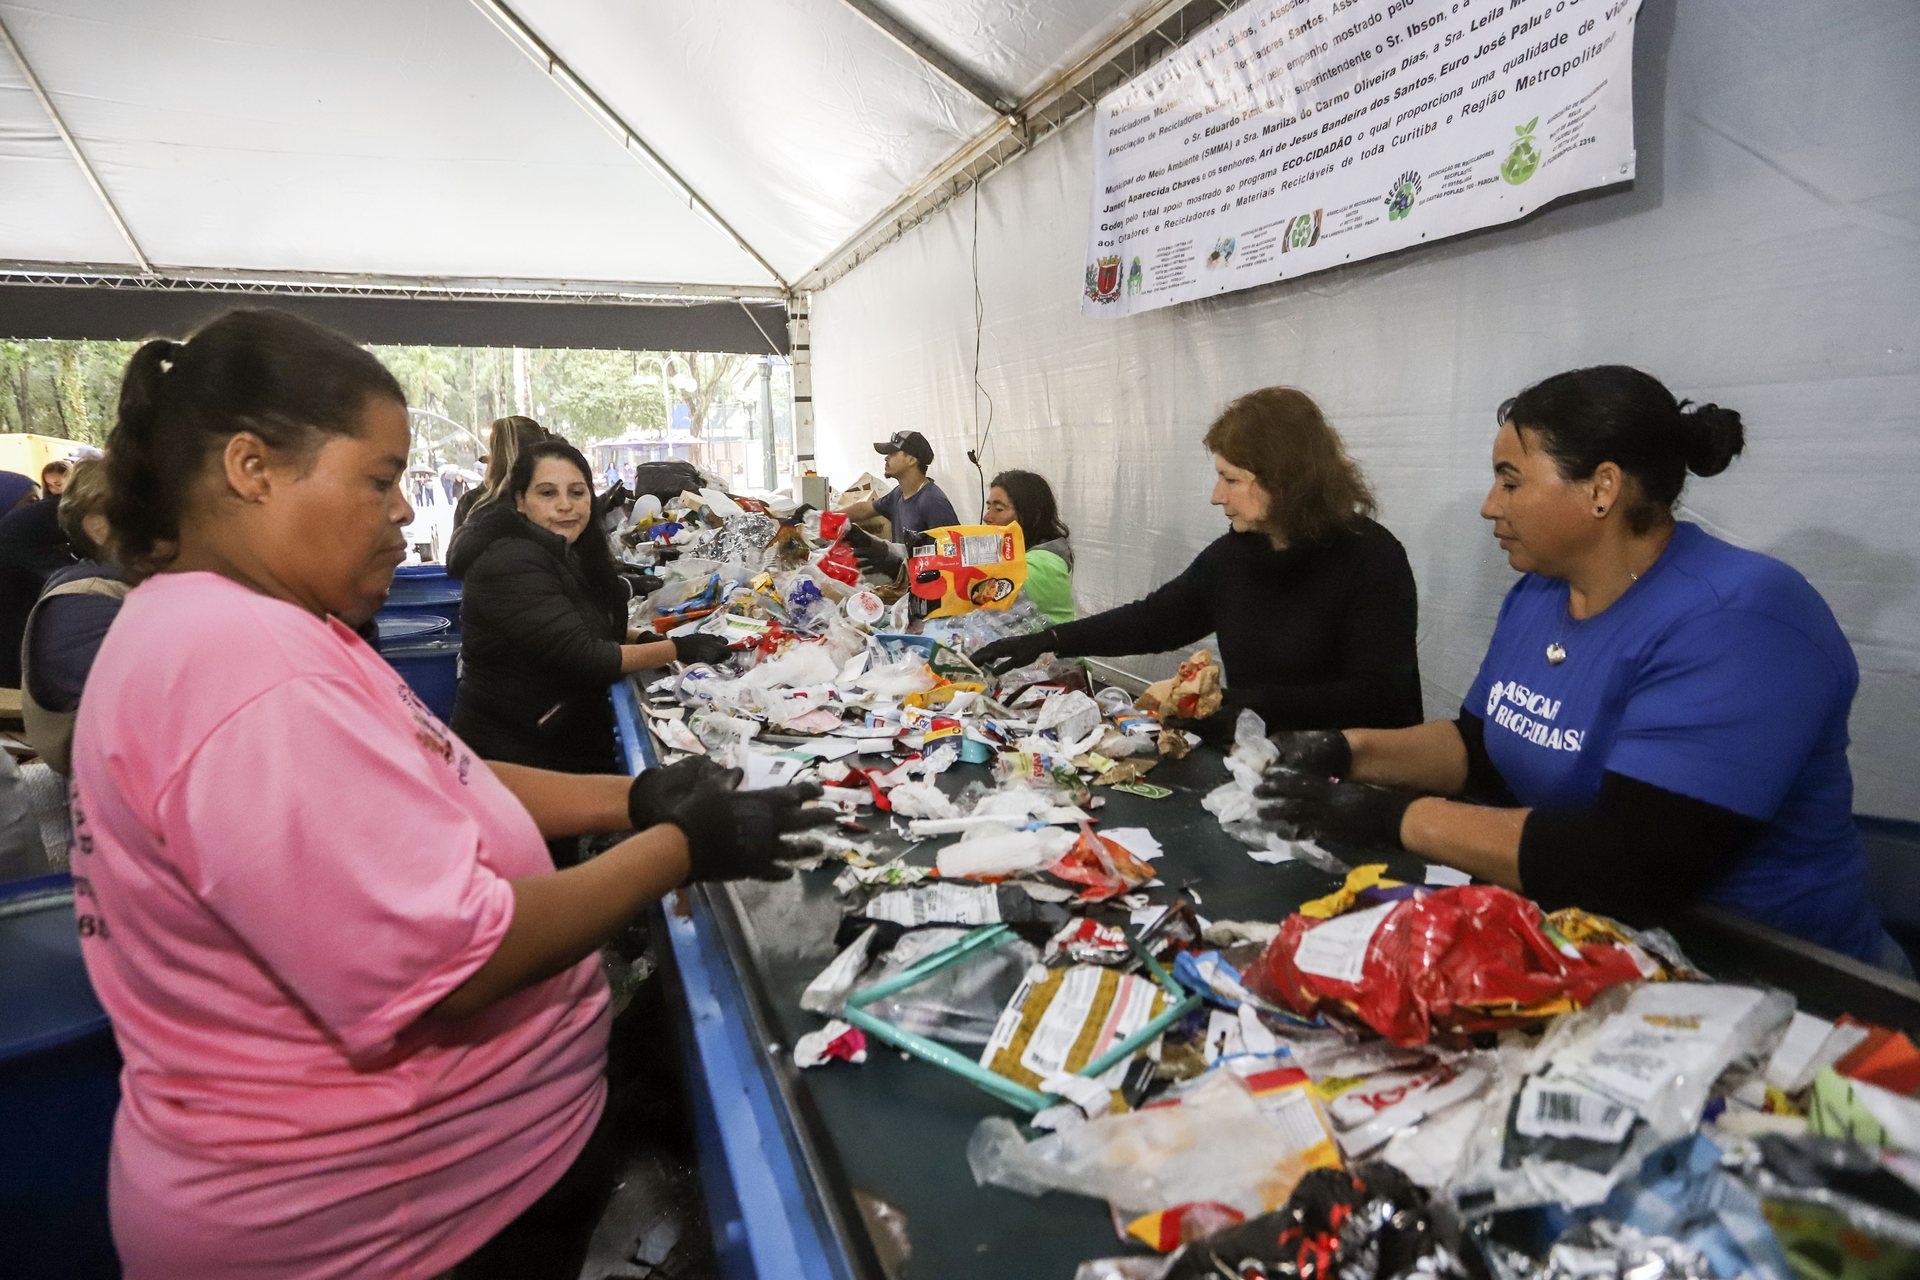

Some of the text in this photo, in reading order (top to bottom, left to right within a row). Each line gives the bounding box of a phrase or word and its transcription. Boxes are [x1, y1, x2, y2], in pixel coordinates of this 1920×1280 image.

[1108, 135, 1146, 158] Associação
[1147, 131, 1156, 142] de
[1158, 110, 1203, 136] Recicladores
[1286, 41, 1329, 71] empenho
[1332, 12, 1383, 47] mostrado
[1127, 186, 1170, 205] Aparecida
[1171, 173, 1201, 192] Chaves
[1207, 169, 1217, 178] os
[1218, 155, 1257, 174] senhores,
[1258, 145, 1273, 160] Ari
[1275, 141, 1287, 153] de
[1289, 127, 1319, 148] Jesus
[1321, 106, 1367, 135] Bandeira
[1369, 95, 1390, 112] dos
[1393, 73, 1438, 100] Santos,
[1439, 54, 1470, 77] Euro
[1473, 31, 1507, 60] José
[1510, 13, 1543, 41] Palu
[1544, 7, 1553, 20] e
[1555, 0, 1566, 13] o
[1136, 171, 1147, 183] do
[1148, 167, 1166, 180] Meio
[1167, 154, 1200, 173] Ambiente
[1200, 140, 1233, 161] (SMMA)
[1235, 138, 1241, 148] a
[1243, 131, 1260, 144] Sra.
[1262, 116, 1297, 135] Marilza
[1299, 107, 1313, 121] do
[1315, 91, 1350, 112] Carmo
[1353, 66, 1397, 95] Oliveira
[1400, 51, 1429, 71] Dias,
[1432, 43, 1441, 54] a
[1444, 29, 1466, 48] Sra.
[1470, 6, 1504, 33] Leila
[1183, 136, 1190, 146] o
[1191, 131, 1202, 143] Sr.
[1204, 116, 1240, 138] Eduardo
[1294, 51, 1373, 95] superintendente
[1375, 44, 1384, 55] o
[1385, 33, 1404, 49] Sr.
[1406, 10, 1448, 39] Ibson,
[1451, 3, 1460, 15] e
[1288, 12, 1329, 41] Santos,
[1096, 239, 1115, 248] aos
[1154, 224, 1160, 233] e
[1163, 208, 1216, 229] Recicladores
[1220, 202, 1231, 214] de
[1235, 186, 1275, 208] Materiais
[1280, 163, 1335, 192] Recicláveis
[1341, 156, 1354, 169] de
[1359, 143, 1385, 161] toda
[1391, 120, 1438, 148] Curitiba
[1446, 114, 1454, 125] e
[1460, 88, 1507, 118] Região
[1125, 212, 1139, 226] pelo
[1162, 199, 1183, 215] apoio
[1186, 187, 1222, 206] mostrado
[1225, 183, 1236, 194] ao
[1238, 168, 1278, 191] programa
[1281, 134, 1353, 172] ECO-CIDADÃO
[1357, 131, 1365, 141] o
[1369, 119, 1392, 138] qual
[1395, 85, 1465, 127] proporciona
[1470, 69, 1496, 91] uma
[1502, 32, 1569, 75] qualidade
[1577, 18, 1595, 37] de
